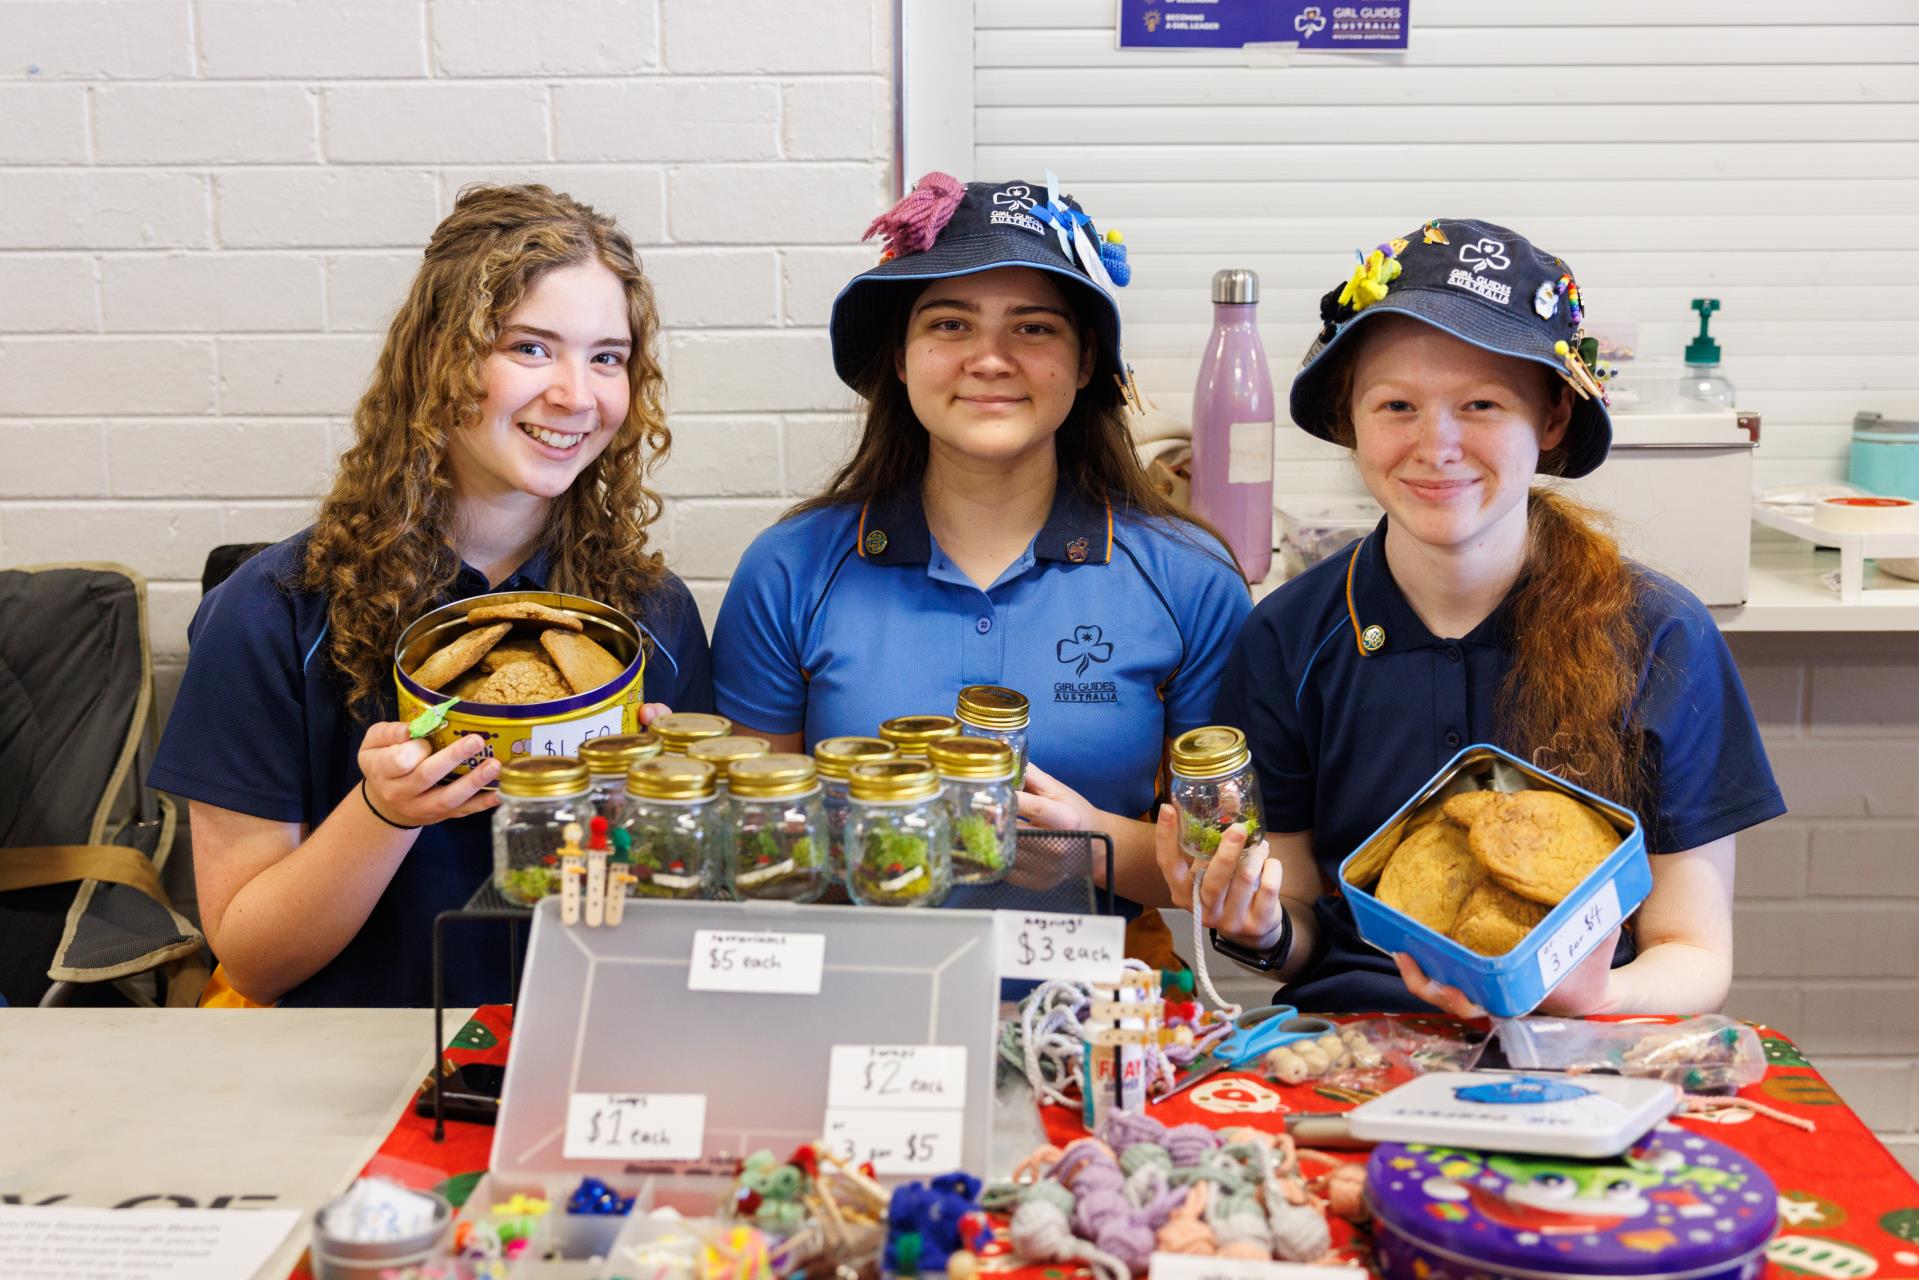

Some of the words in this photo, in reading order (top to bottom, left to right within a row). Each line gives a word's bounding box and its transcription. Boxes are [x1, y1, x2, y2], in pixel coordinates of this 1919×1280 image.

[1333, 7, 1359, 18] GIRL
[1360, 7, 1401, 18] GUIDES
[1333, 22, 1400, 30] AUSTRALIA
[991, 210, 1010, 218] GIRL
[1447, 276, 1510, 304] AUSTRALIA
[1450, 269, 1473, 280] GIRL
[1476, 275, 1512, 294] GUIDES
[1054, 682, 1078, 692] GIRL
[1078, 682, 1116, 692] GUIDES
[1054, 693, 1118, 701] AUSTRALIA
[1016, 932, 1054, 965] $3
[1063, 948, 1110, 961] each
[1551, 952, 1561, 972] 3
[1568, 935, 1584, 957] for
[1584, 903, 1603, 931] $4
[709, 947, 736, 970] $5
[743, 953, 781, 969] each
[864, 1060, 902, 1095] $2
[910, 1079, 944, 1093] each
[587, 1109, 622, 1146] $1
[630, 1129, 670, 1146] each
[844, 1138, 856, 1160] 3
[904, 1133, 939, 1162] $5
